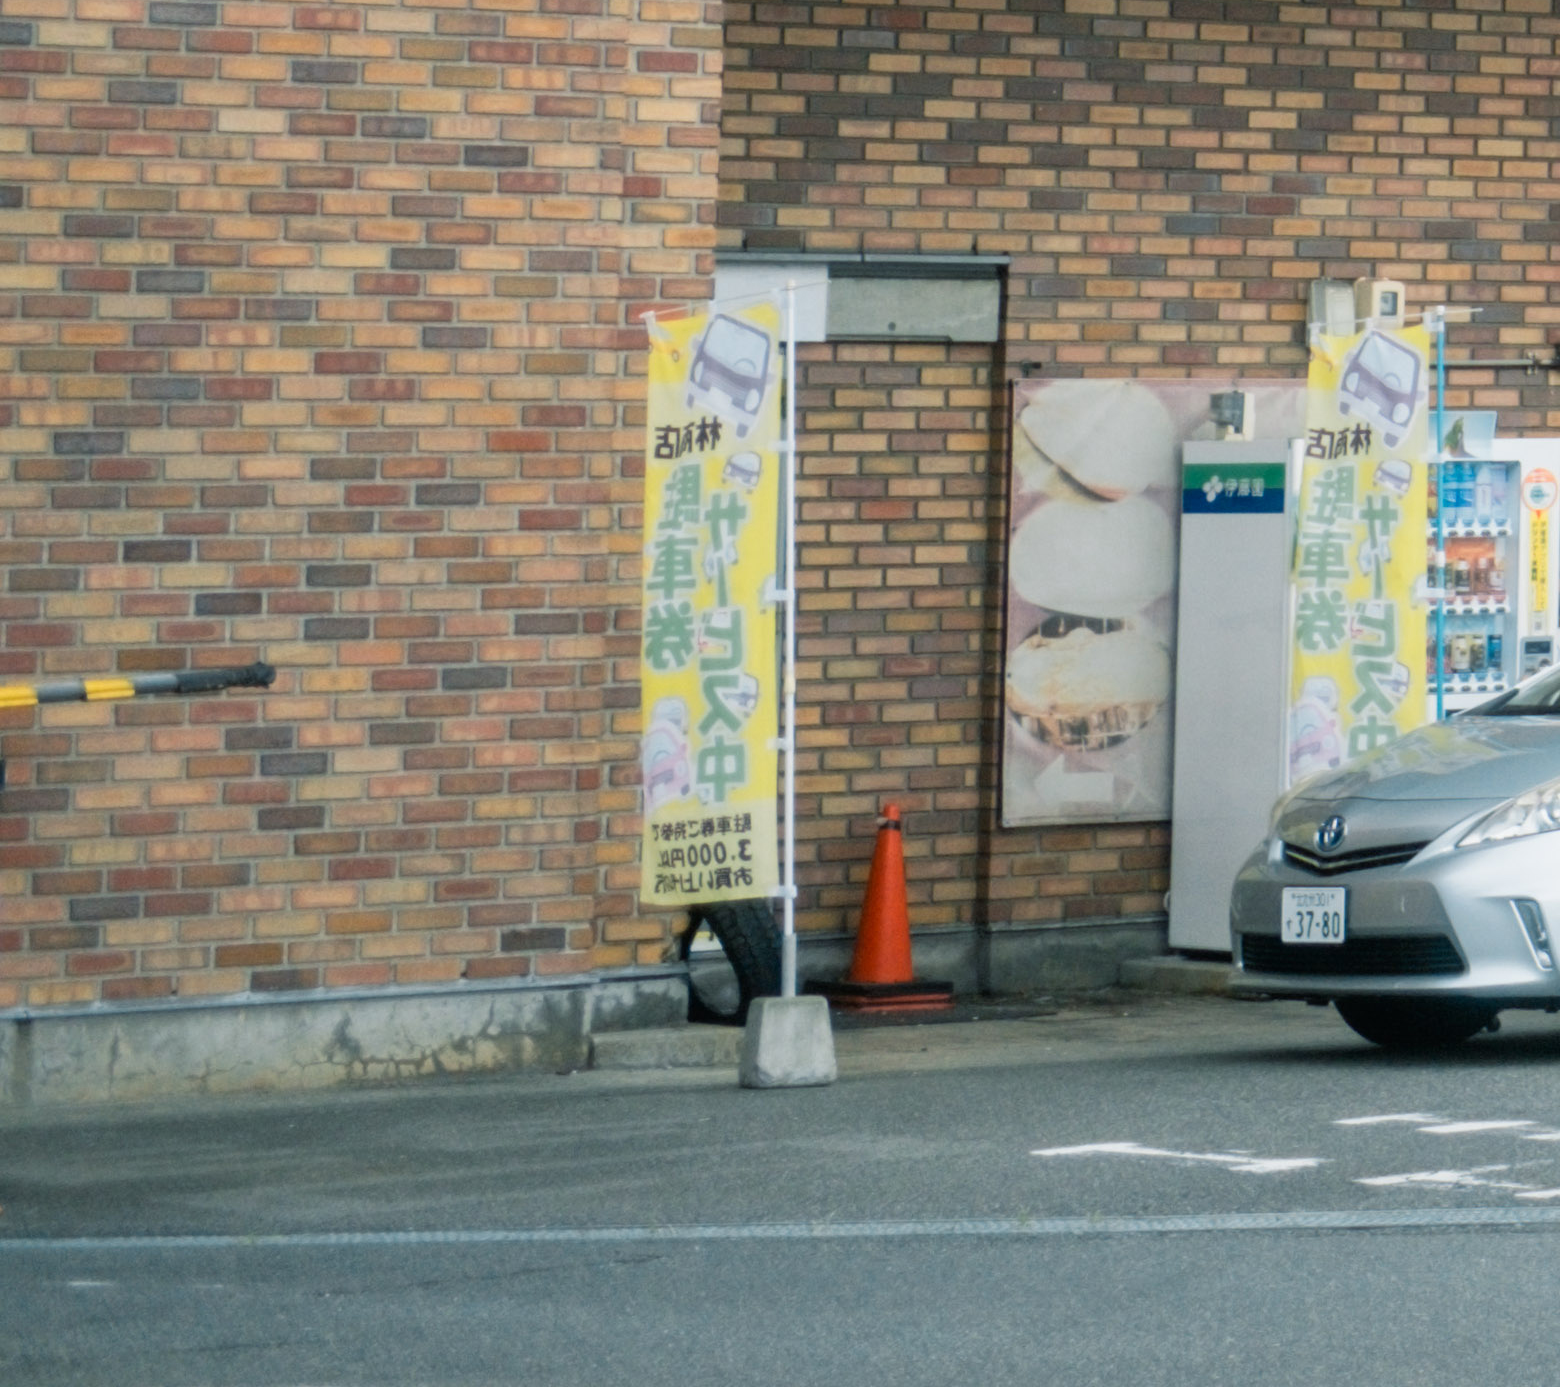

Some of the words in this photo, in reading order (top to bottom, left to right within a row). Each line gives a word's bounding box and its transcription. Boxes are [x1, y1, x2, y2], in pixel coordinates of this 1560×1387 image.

[1224, 478, 1265, 497] 伊藤園
[1296, 910, 1340, 939] 37-80
